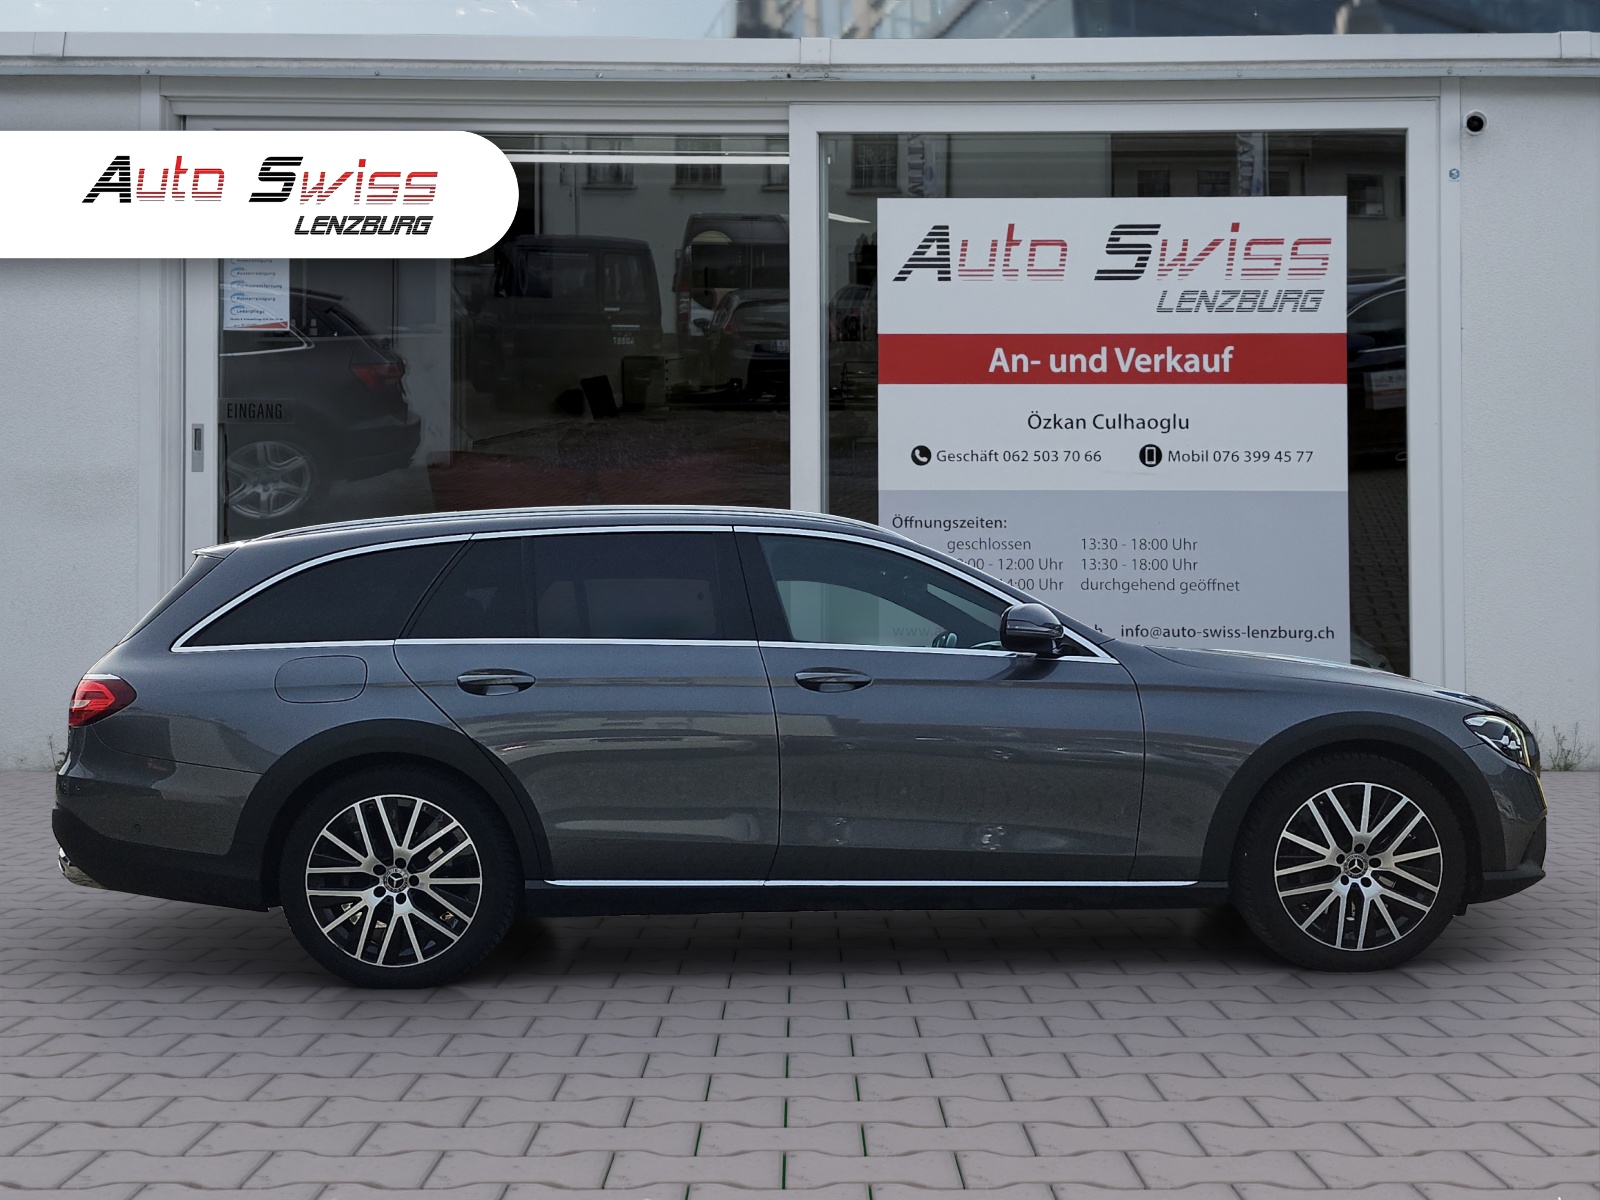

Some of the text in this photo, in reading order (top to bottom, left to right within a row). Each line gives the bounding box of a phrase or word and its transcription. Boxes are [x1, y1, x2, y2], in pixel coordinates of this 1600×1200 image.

[893, 221, 1332, 282] Auto Swiss
[1157, 289, 1326, 313] LENZBURG
[988, 345, 1234, 373] An- und Verkauf
[227, 403, 283, 419] EINGANG
[1028, 411, 1190, 434] Özkan Culhaoglu
[936, 449, 1102, 463] Geschäft 062 503 70 66
[1168, 449, 1314, 463] Mobil 076 399 45 77
[892, 513, 1007, 532] Öffnungszeiten:
[947, 537, 1031, 554] geschlossen
[1081, 538, 1118, 551] 13:30
[1132, 538, 1168, 551] 18:00
[1172, 537, 1198, 551] Uhr
[999, 558, 1035, 571] 12:00
[1038, 557, 1064, 571] Uhr
[1081, 558, 1118, 571] 13:30
[1132, 558, 1168, 571] 18:00
[1172, 557, 1198, 571] Uhr
[1038, 578, 1064, 591] Uhr
[1080, 577, 1240, 595] durchgehend geöffnet
[1120, 624, 1335, 643] info@auto-swiss-lenzburg.ch
